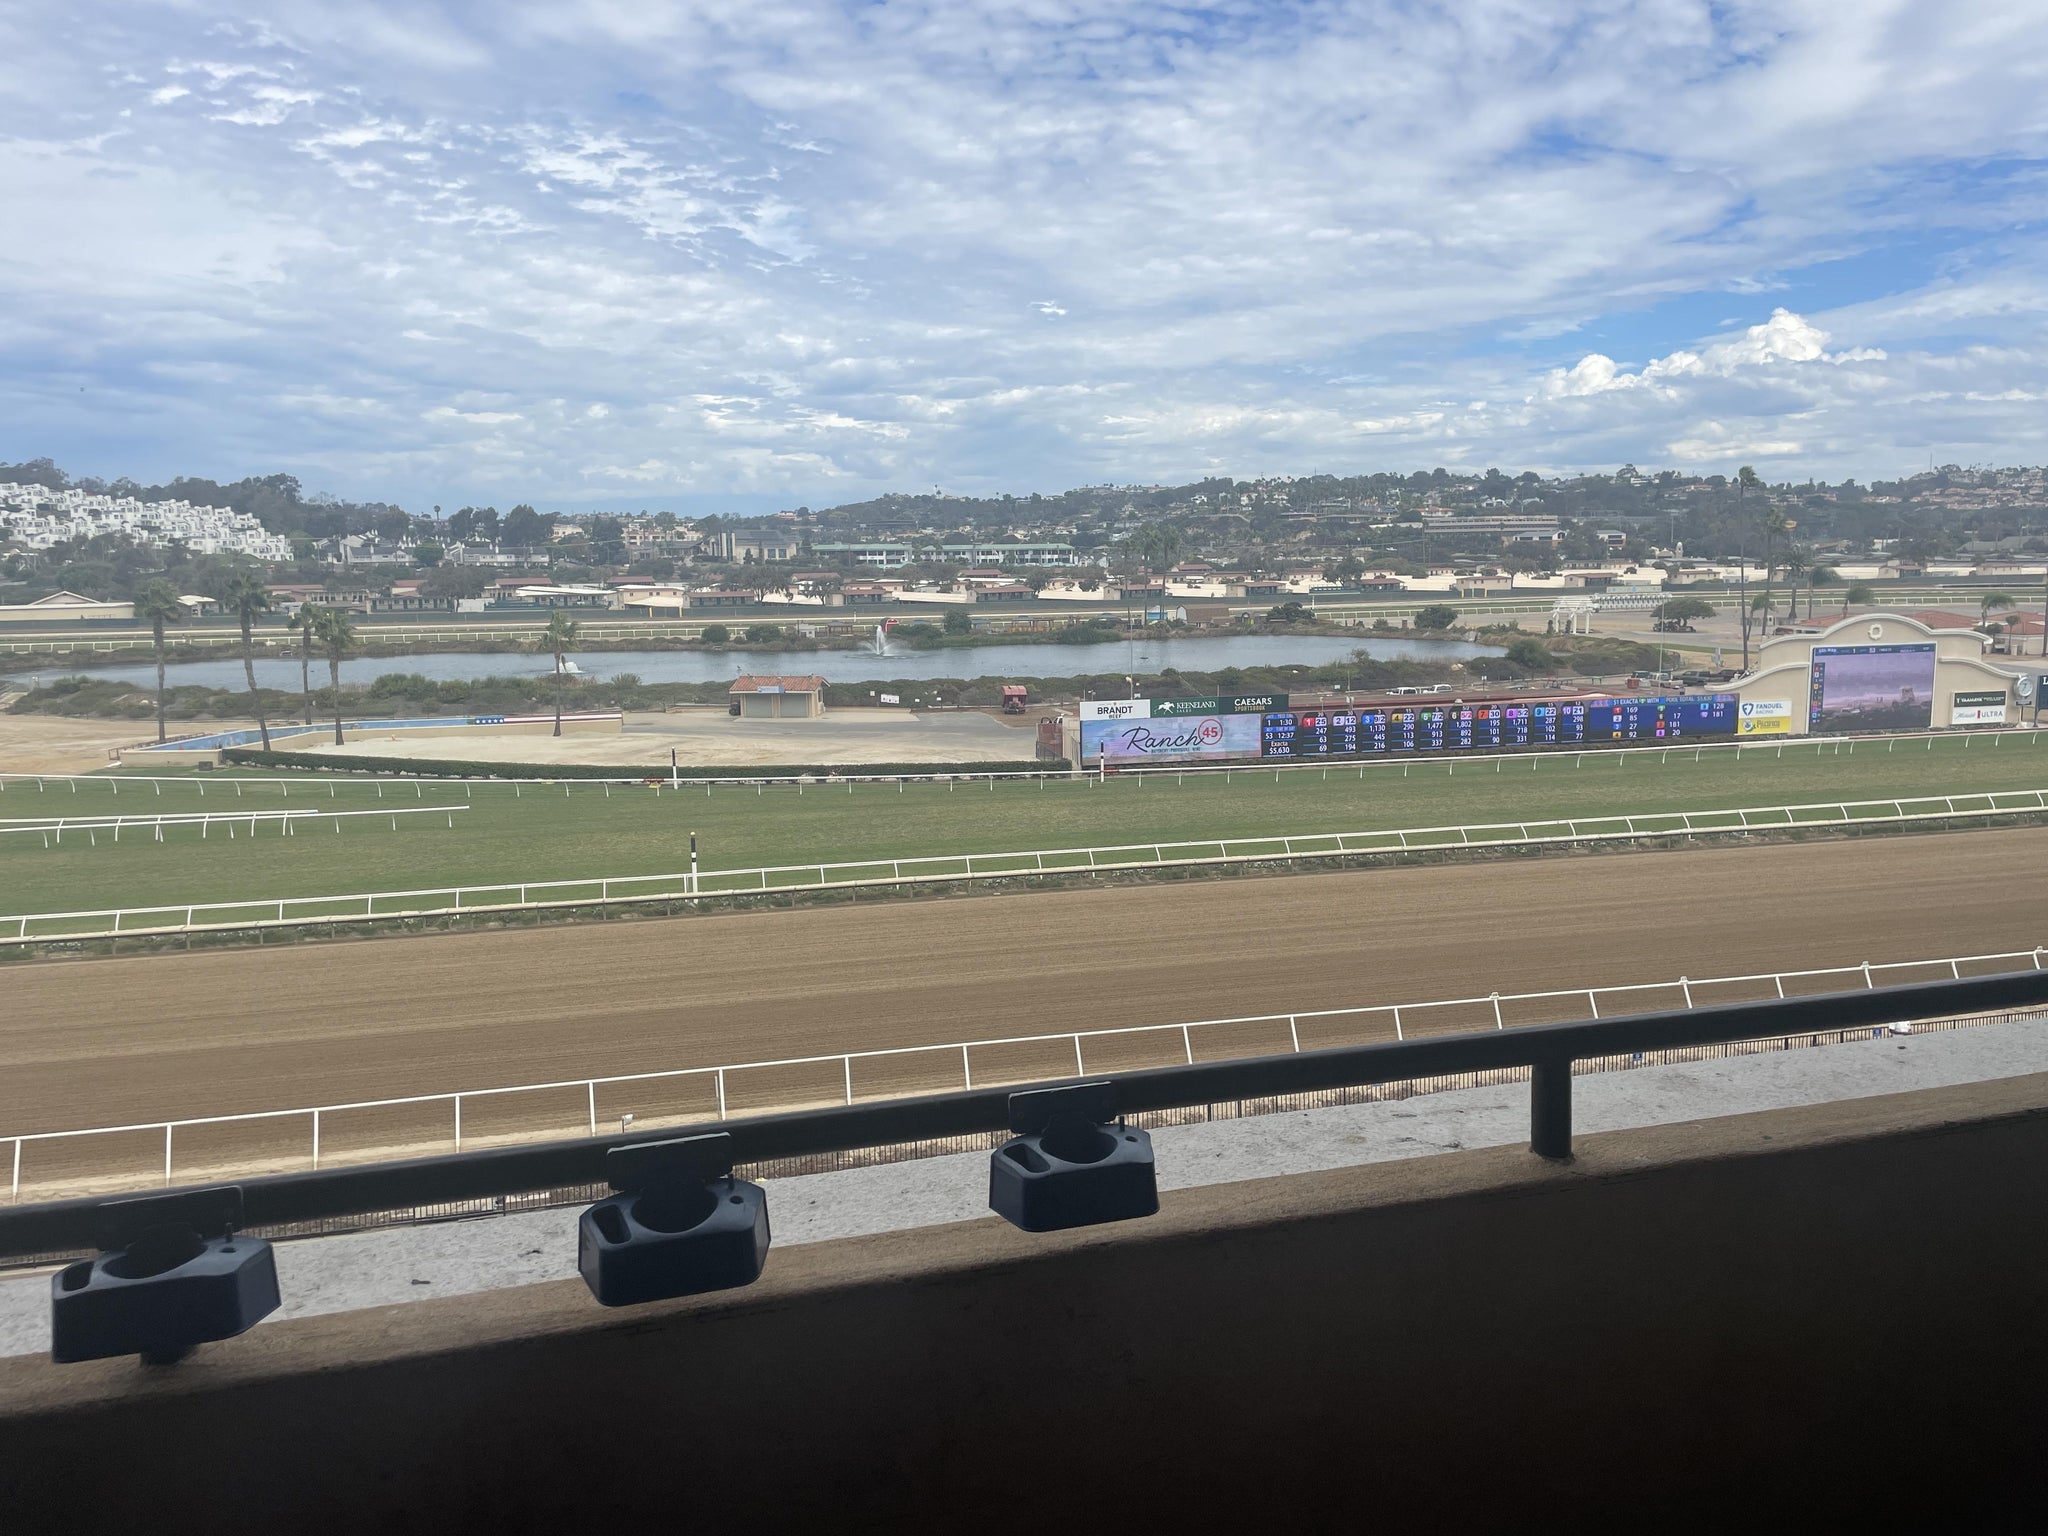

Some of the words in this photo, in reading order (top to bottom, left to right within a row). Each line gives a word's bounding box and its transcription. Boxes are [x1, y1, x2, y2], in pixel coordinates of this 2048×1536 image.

[1234, 697, 1272, 706] CAESARS
[1097, 706, 1133, 714] BRANDT
[1122, 726, 1204, 752] Ranch
[1203, 727, 1218, 737] 45
[1269, 747, 1290, 755] $5,630
